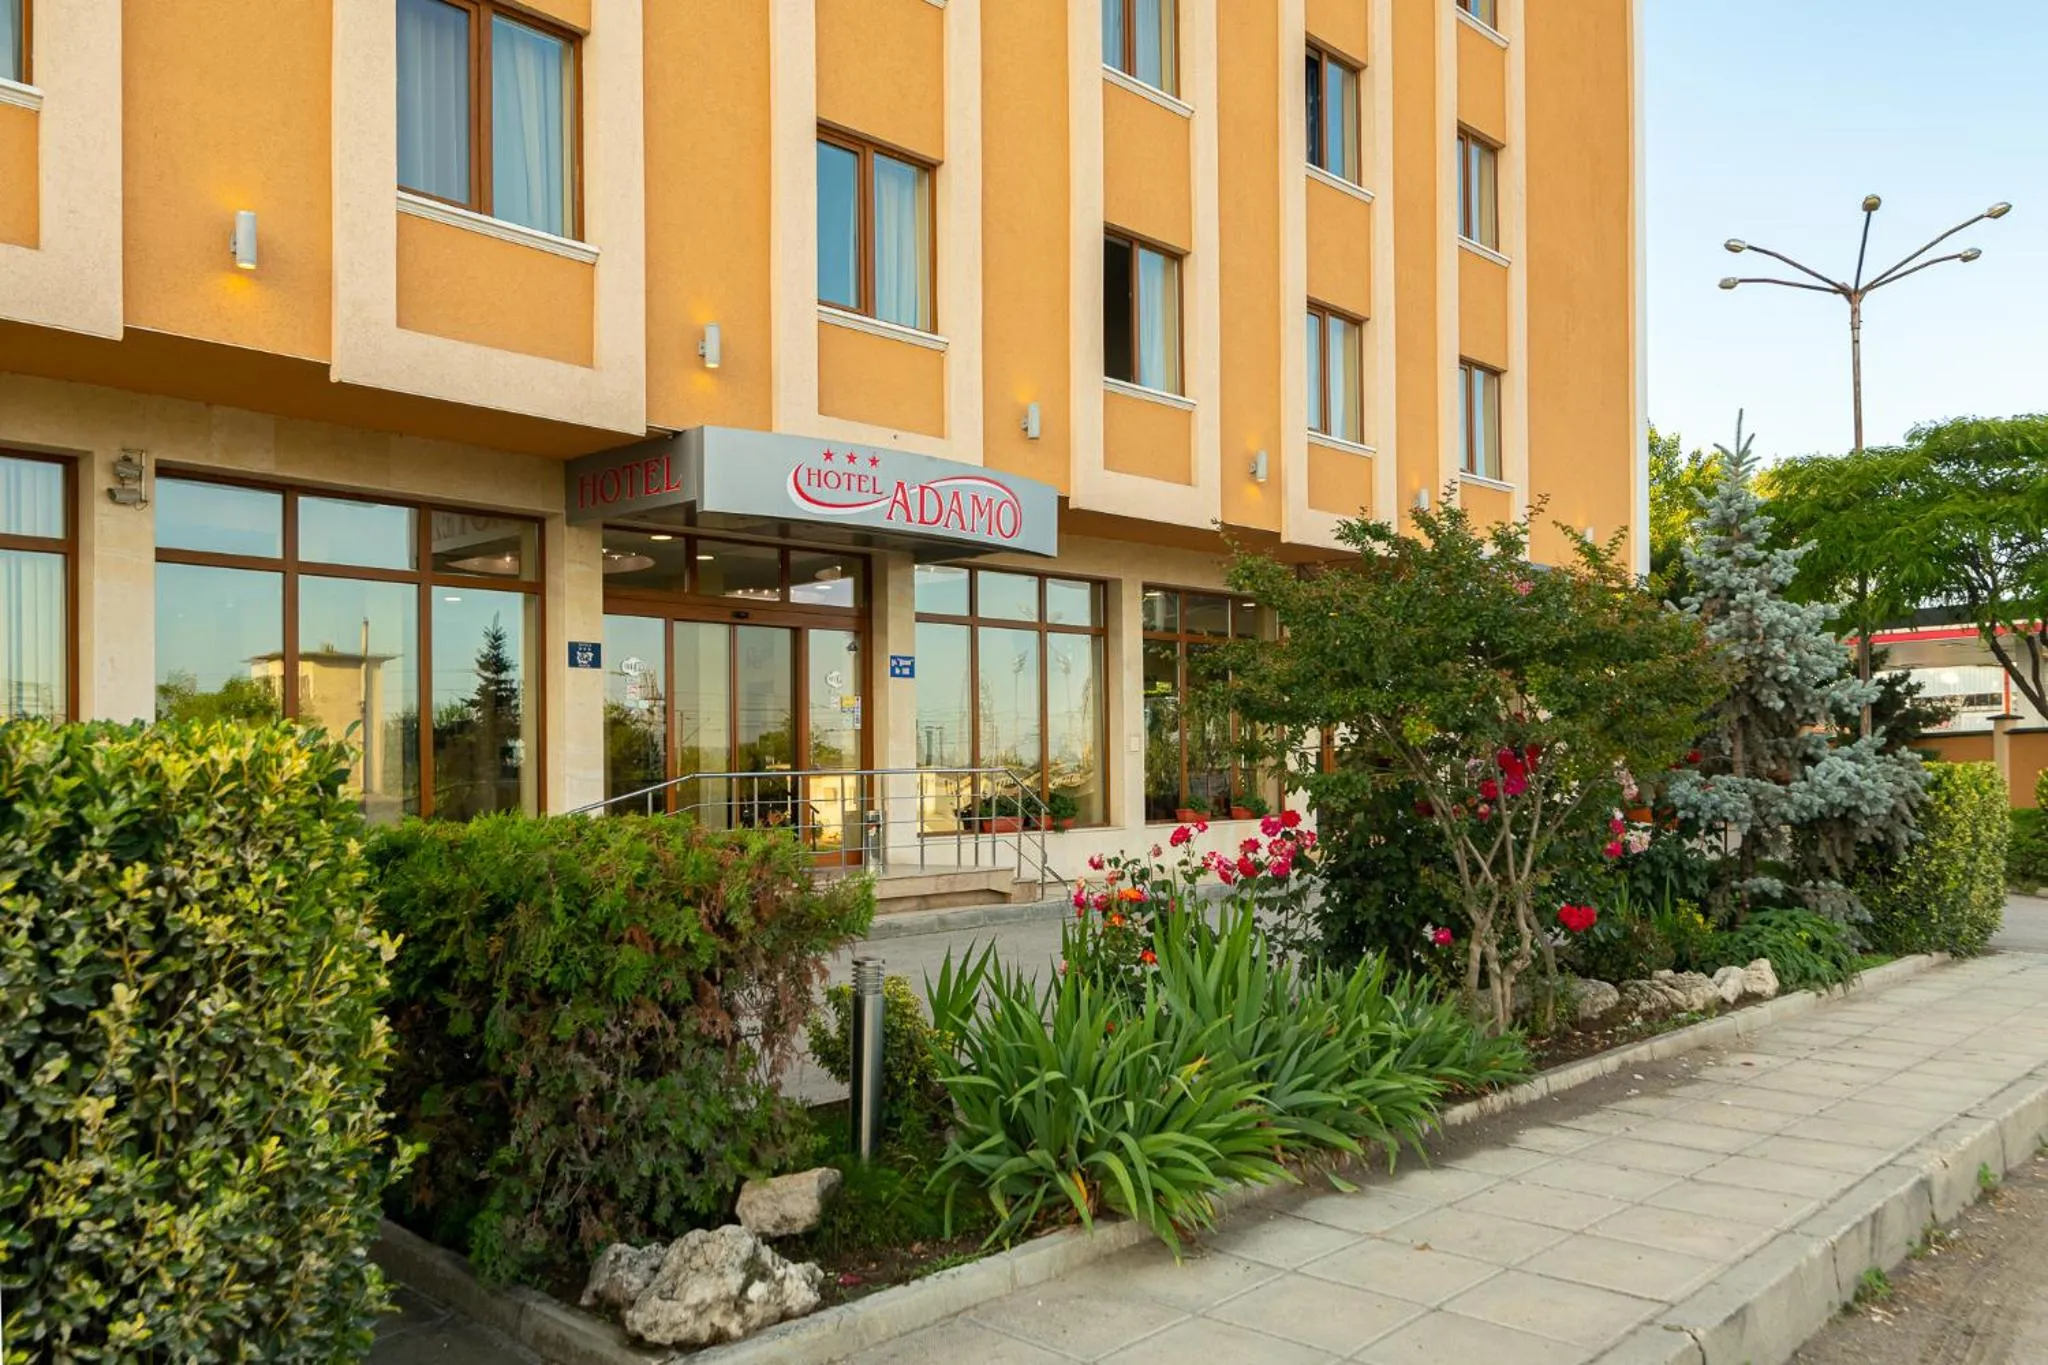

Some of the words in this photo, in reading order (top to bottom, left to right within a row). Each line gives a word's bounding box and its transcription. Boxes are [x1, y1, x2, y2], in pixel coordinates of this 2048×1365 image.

[577, 454, 683, 511] HOTEL
[806, 467, 883, 495] HOTEL
[886, 480, 1020, 540] ADAMO
